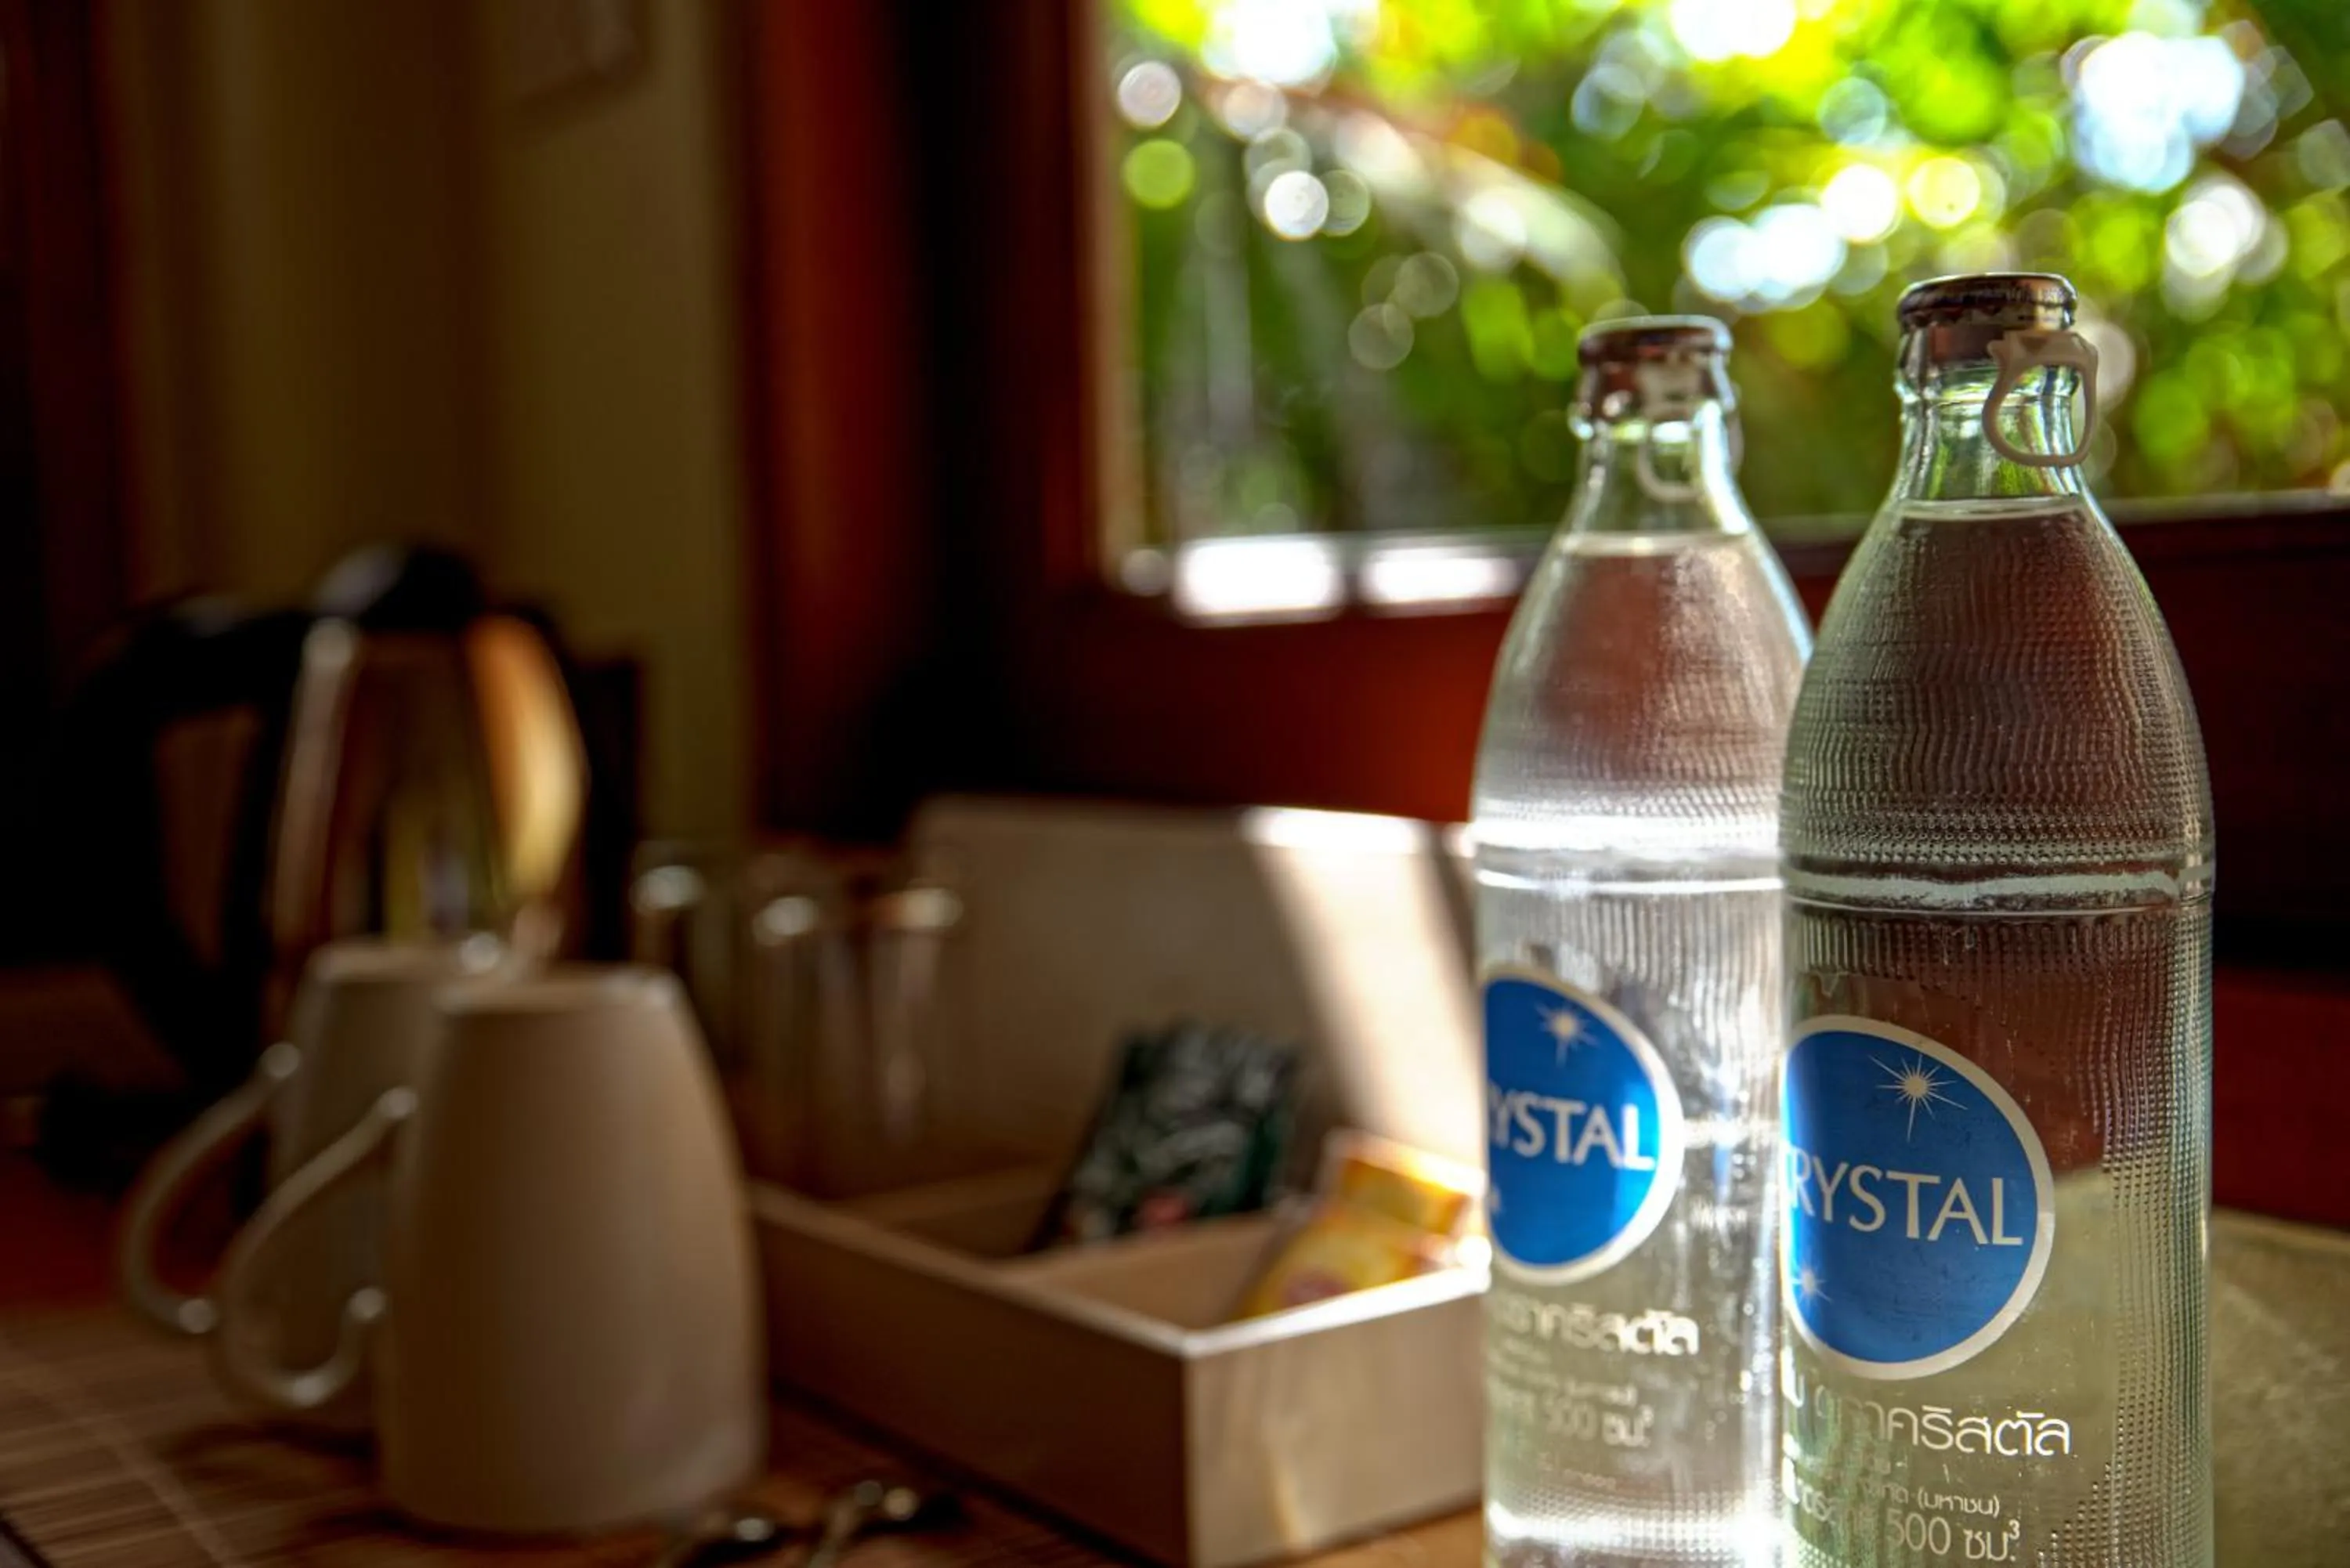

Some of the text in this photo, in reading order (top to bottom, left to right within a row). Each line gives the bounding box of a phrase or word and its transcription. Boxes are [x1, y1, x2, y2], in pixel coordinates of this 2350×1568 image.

[1488, 1080, 1655, 1171] YSTAL
[1783, 1143, 2023, 1245] RYSTAL
[1886, 1507, 1952, 1555] 500
